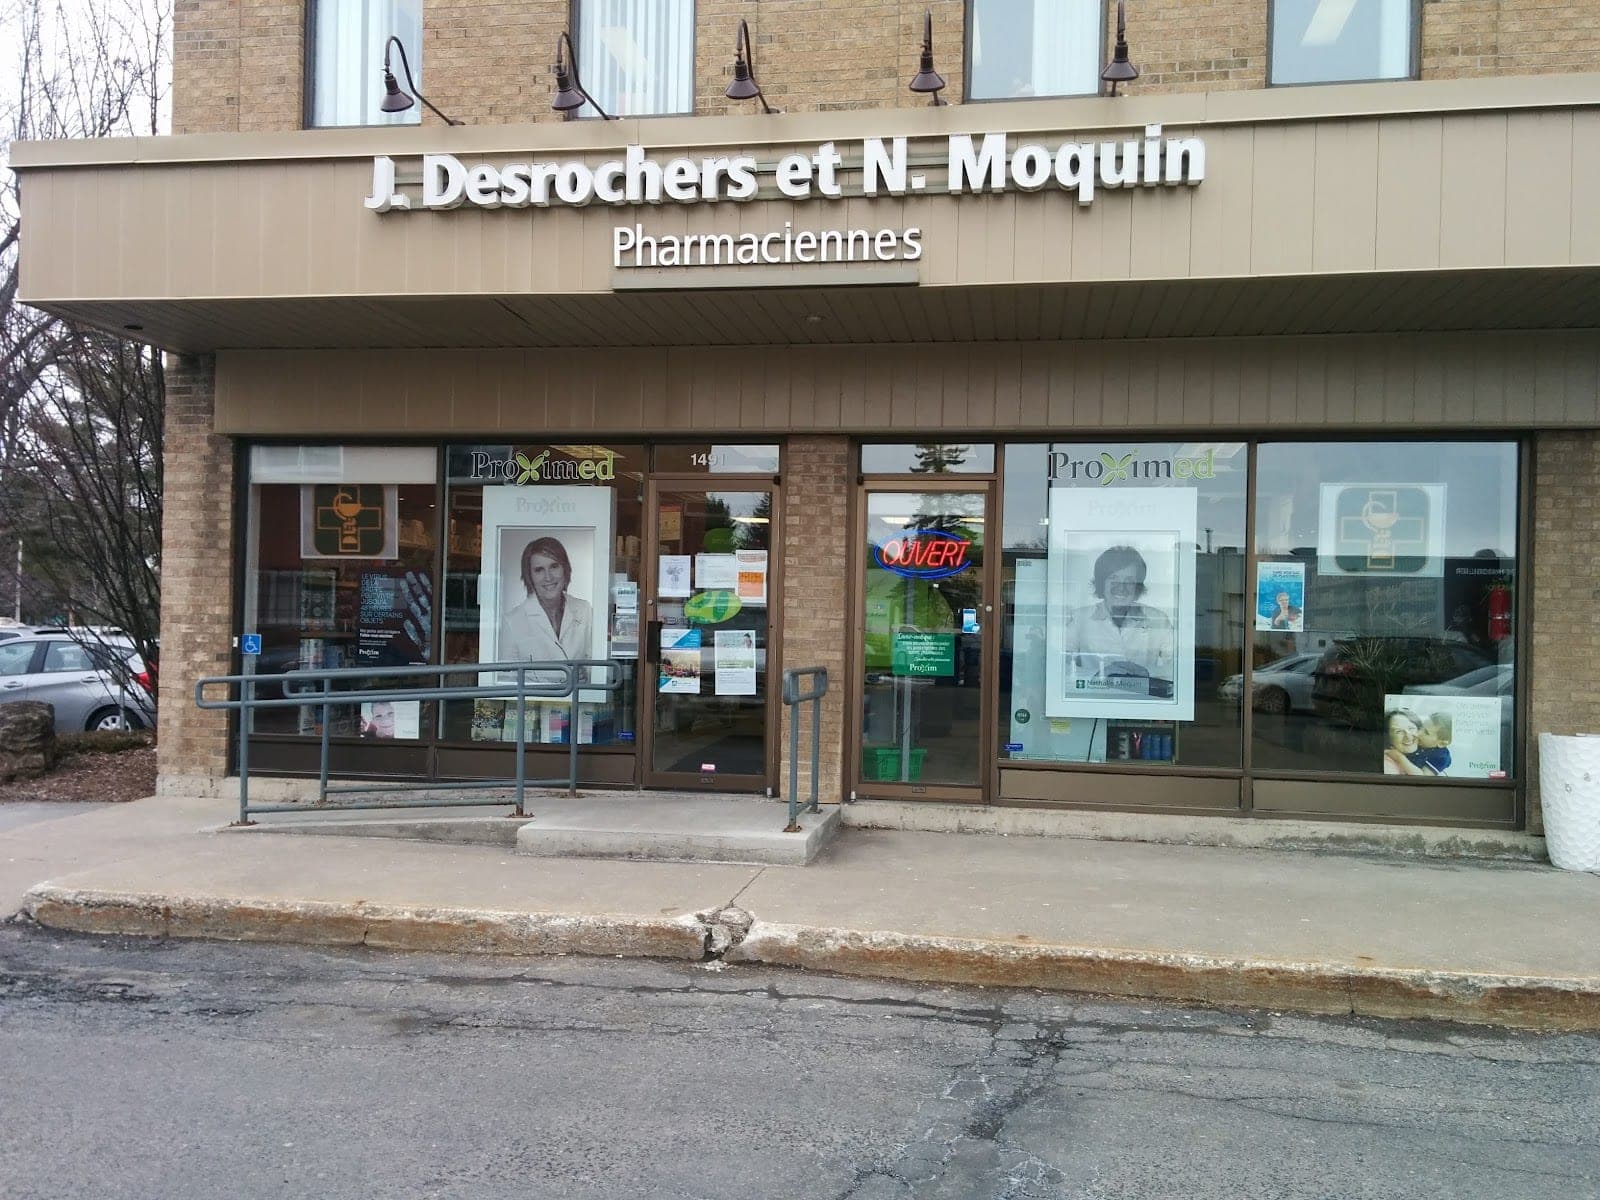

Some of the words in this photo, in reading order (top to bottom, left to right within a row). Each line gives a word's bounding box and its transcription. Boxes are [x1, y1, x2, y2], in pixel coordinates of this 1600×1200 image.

[364, 156, 410, 212] J.
[422, 144, 758, 210] Desrochers
[776, 141, 842, 199] et
[863, 136, 926, 197] N.
[948, 123, 1206, 206] Moquin
[613, 221, 922, 267] Pharmaciennes
[690, 453, 726, 466] 1491
[883, 540, 971, 567] OUVERT
